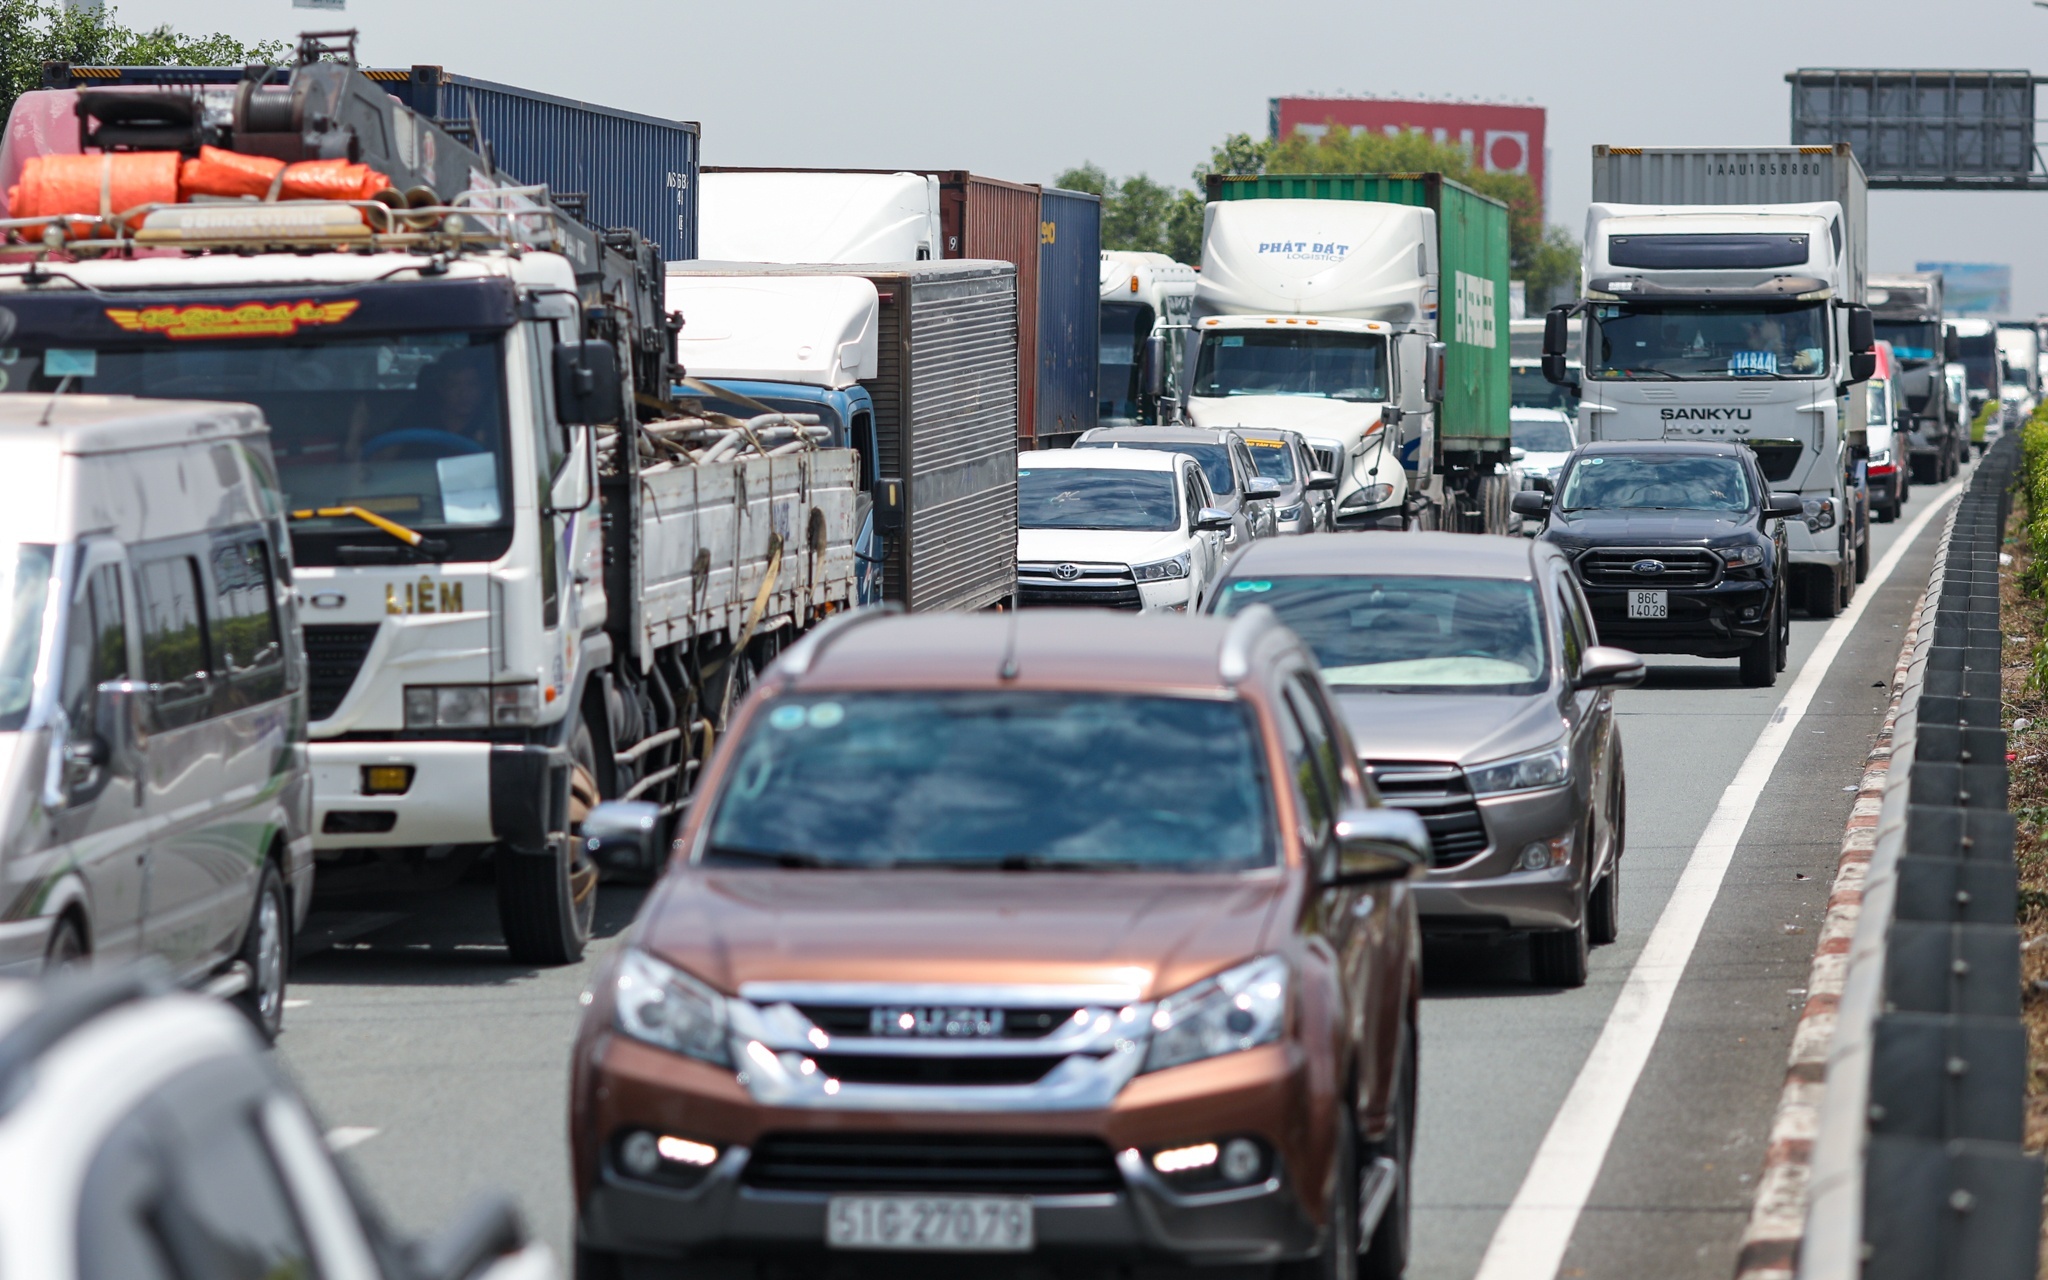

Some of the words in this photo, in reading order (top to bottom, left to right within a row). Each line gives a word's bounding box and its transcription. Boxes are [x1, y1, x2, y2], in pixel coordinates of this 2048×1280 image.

[1286, 253, 1344, 262] LOGISTICS
[1660, 408, 1752, 420] SANKYU
[385, 575, 463, 614] LIÊM
[1637, 592, 1658, 604] 86C
[1630, 605, 1666, 617] 140.28
[870, 1007, 1004, 1037] ISUZU
